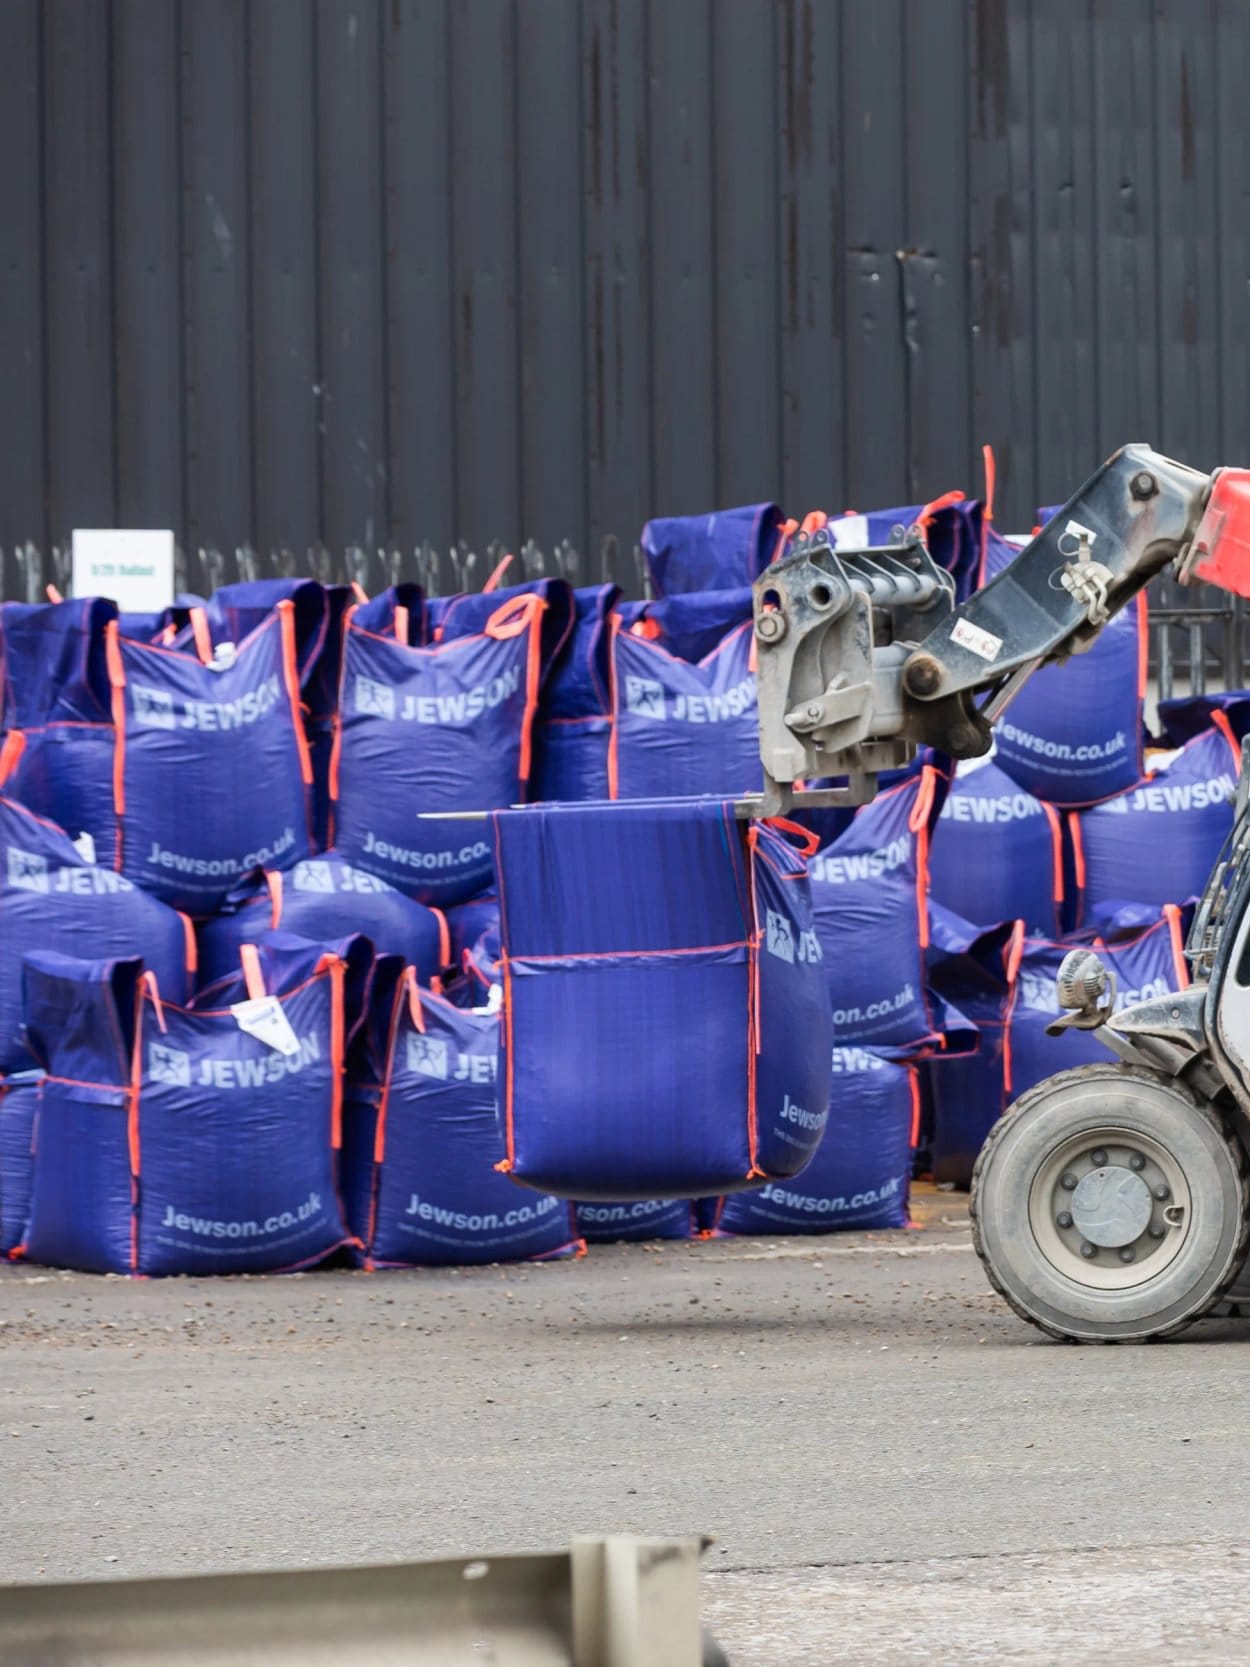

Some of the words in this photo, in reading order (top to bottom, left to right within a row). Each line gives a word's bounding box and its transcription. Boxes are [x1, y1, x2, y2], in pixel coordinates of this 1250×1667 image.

[179, 672, 281, 732] JEWSON
[401, 664, 521, 724] JEWSON
[1132, 772, 1236, 812] JEWSON
[147, 826, 296, 876] Jewson.co.uk
[811, 834, 912, 884] JEWSON
[197, 1031, 322, 1089] JEWSON
[161, 1191, 323, 1238] Jewson.co.uk
[758, 1176, 903, 1213] Jewson.co.uk
